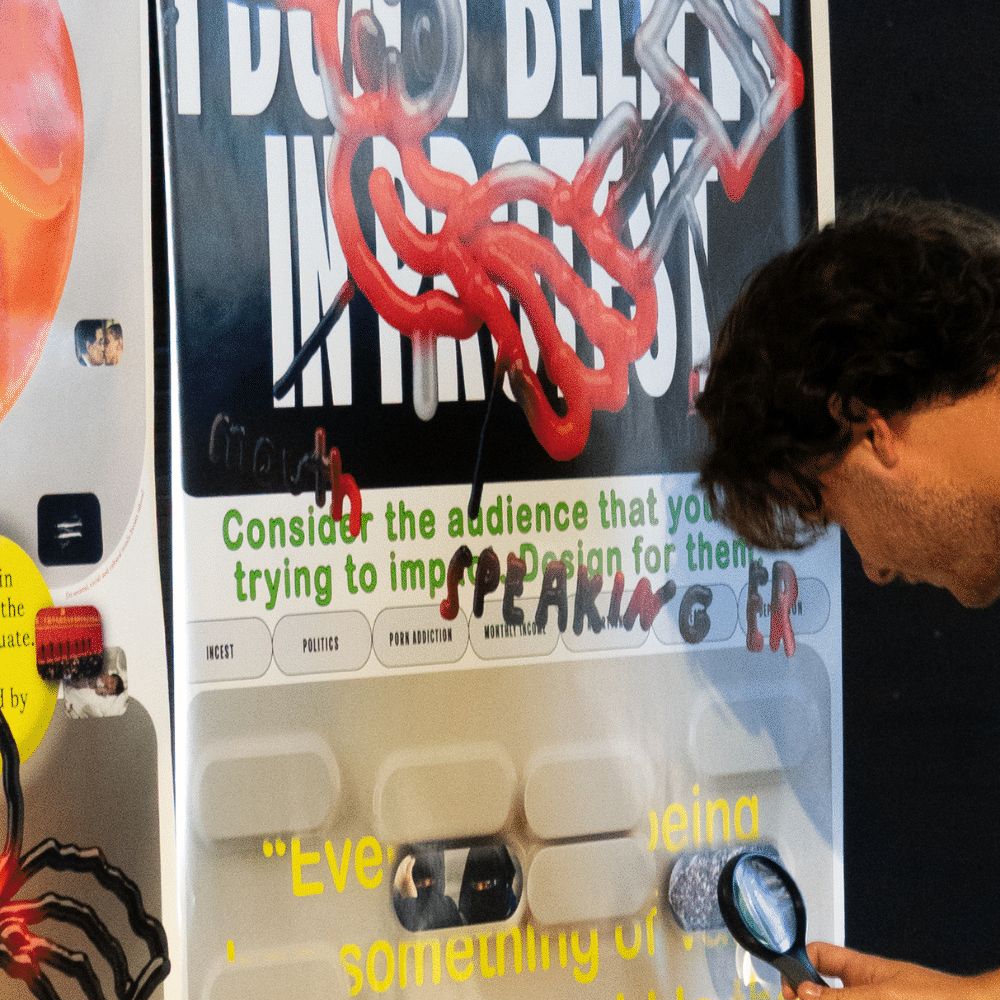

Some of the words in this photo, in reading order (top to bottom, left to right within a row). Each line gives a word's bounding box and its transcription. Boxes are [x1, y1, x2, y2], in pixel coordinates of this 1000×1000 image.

[222, 504, 374, 551] Consider
[385, 500, 436, 542] the
[447, 493, 589, 538] audience
[598, 487, 660, 530] that
[234, 557, 333, 611] trying
[345, 552, 378, 594] to
[632, 535, 676, 575] for
[1, 597, 25, 618] the
[302, 635, 340, 654] POLITICS
[389, 630, 411, 647] PORN
[412, 627, 454, 645] ADDICTION
[206, 643, 235, 661] INCEST
[10, 687, 28, 714] by
[262, 835, 396, 897] “Eve
[339, 923, 599, 997] something
